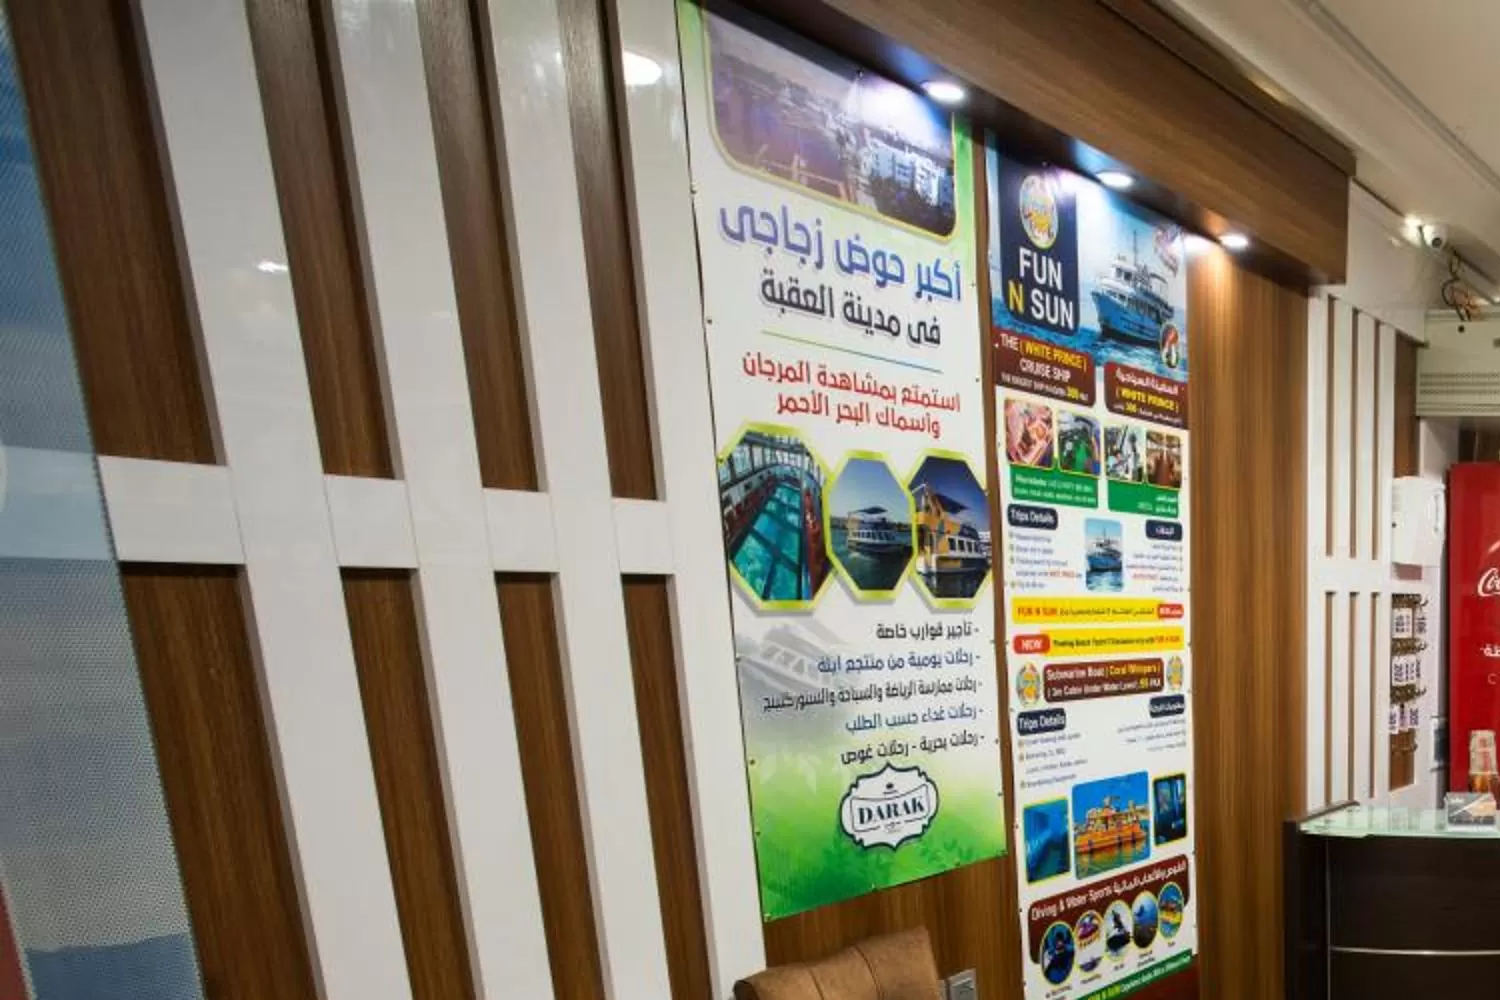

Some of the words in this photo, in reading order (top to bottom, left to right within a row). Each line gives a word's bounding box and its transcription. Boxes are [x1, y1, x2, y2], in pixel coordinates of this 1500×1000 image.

[834, 234, 904, 288] حوض
[1019, 247, 1063, 291] FUN
[915, 258, 961, 301] أكبر
[761, 268, 835, 319] العقبة
[843, 291, 900, 337] مدينة
[1008, 279, 1025, 314] N
[1030, 288, 1074, 331] SUN
[1000, 333, 1019, 351] THE
[742, 351, 811, 385] المرجان
[817, 364, 897, 406] بمشاهدة
[901, 384, 961, 412] استمتع
[835, 401, 870, 427] البحر
[877, 623, 907, 640] خاصة
[910, 623, 943, 641] قوارب
[845, 654, 883, 674] منتجع
[887, 655, 905, 671] من
[907, 652, 942, 669] يومية
[945, 648, 973, 665] رحلات
[885, 712, 919, 727] حسب
[948, 703, 977, 720] رحلات
[845, 713, 881, 733] الطلب
[1019, 717, 1038, 731] Trips
[1039, 713, 1066, 726] Details
[919, 735, 947, 753] بحرية
[951, 729, 979, 748] رحلات
[841, 746, 873, 765] غوص
[858, 795, 924, 825] DARAK
[1031, 903, 1058, 921] Diving
